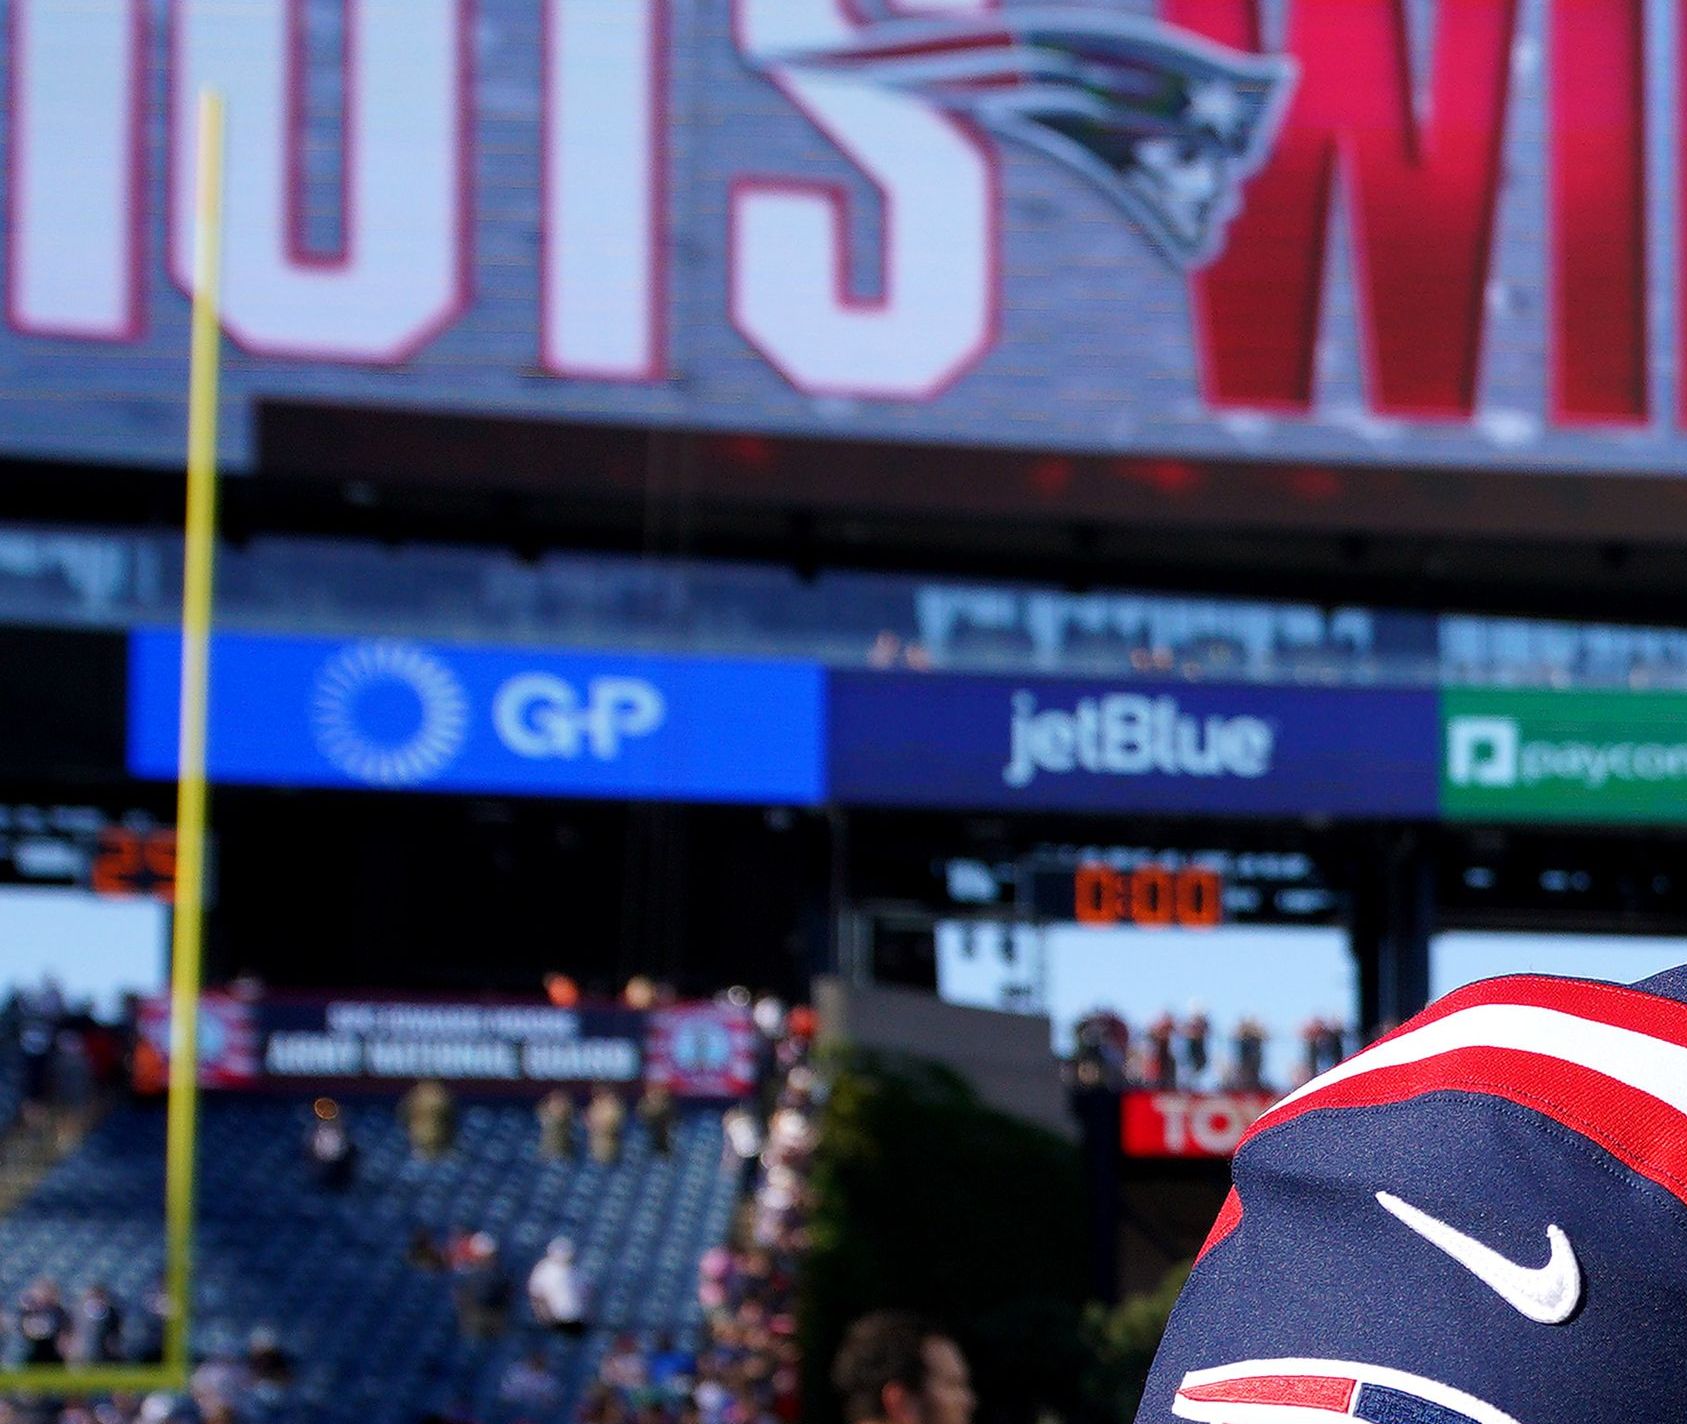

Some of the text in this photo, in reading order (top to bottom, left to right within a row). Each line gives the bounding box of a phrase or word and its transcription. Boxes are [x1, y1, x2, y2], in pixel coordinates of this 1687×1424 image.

[493, 672, 666, 761] GP
[1003, 692, 1272, 789] jetBlue
[1074, 863, 1222, 928] 0:00
[1151, 1096, 1262, 1153] TO
